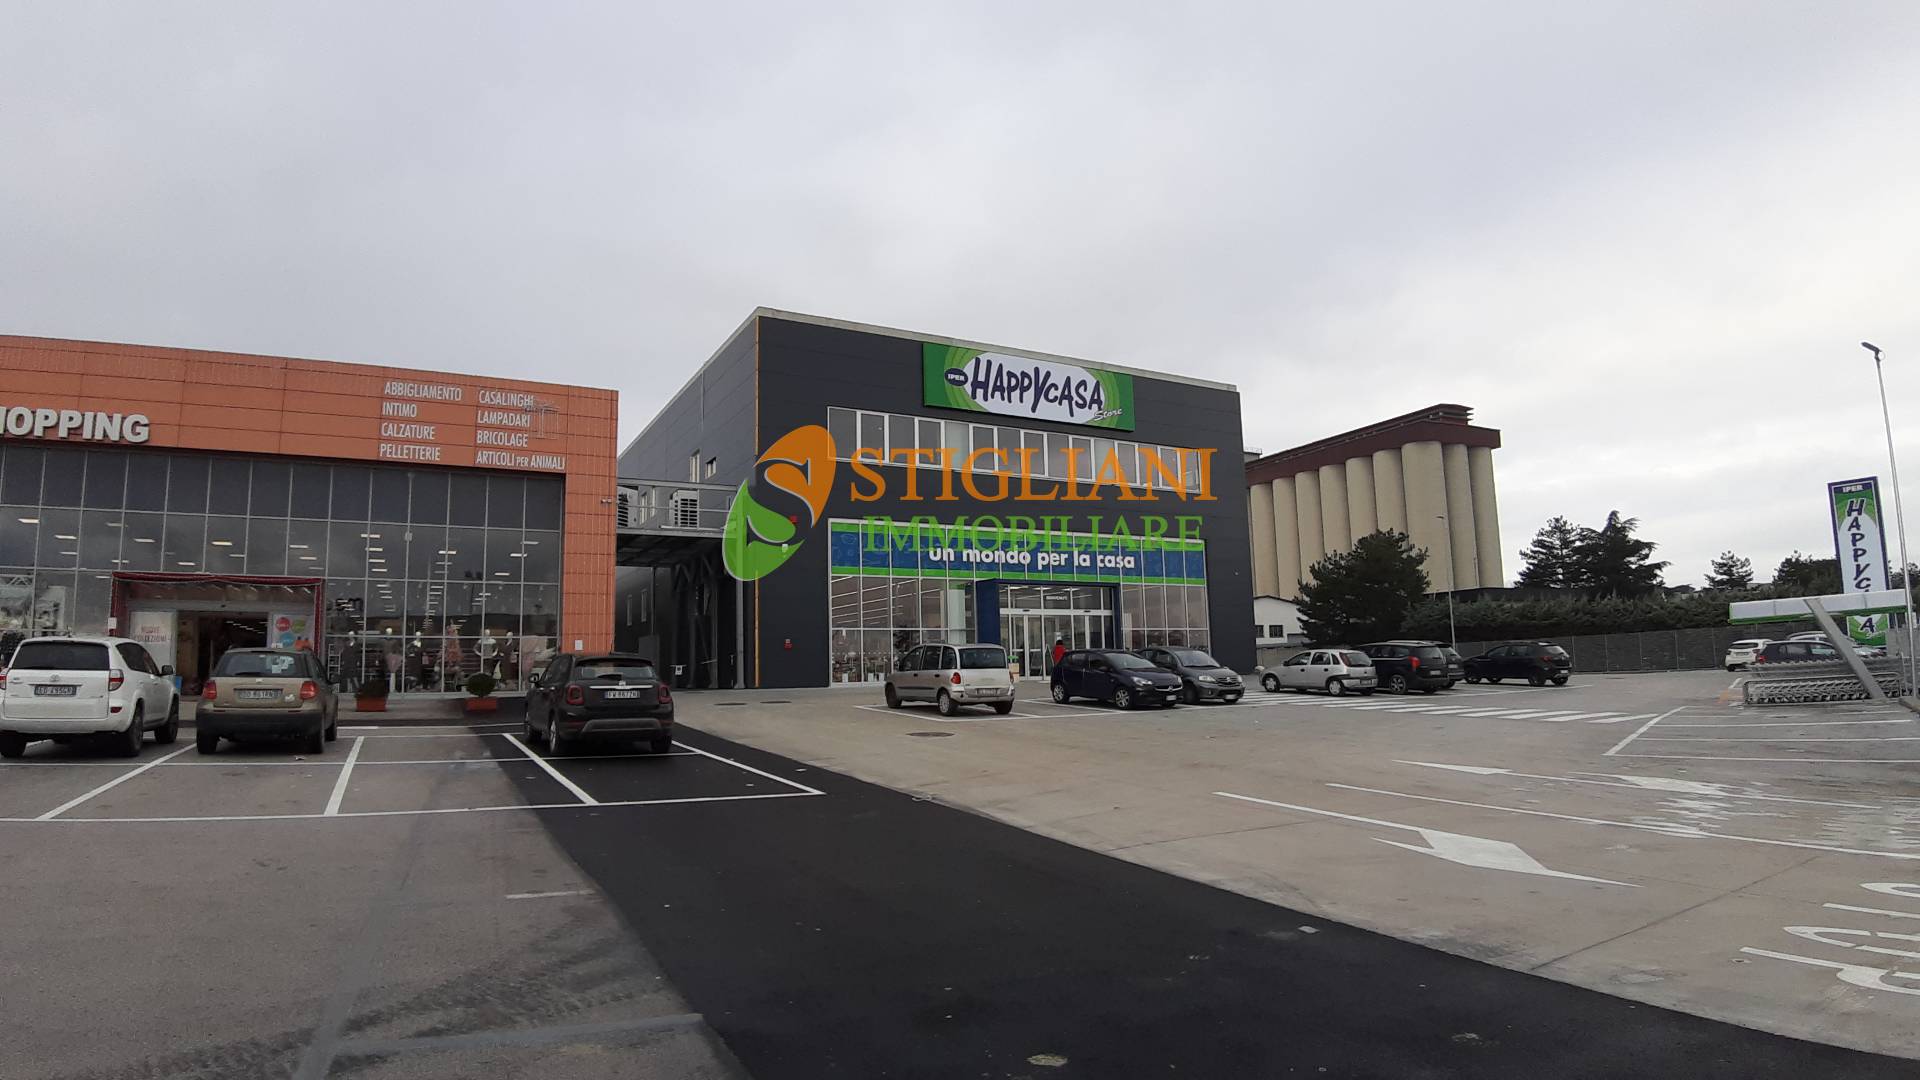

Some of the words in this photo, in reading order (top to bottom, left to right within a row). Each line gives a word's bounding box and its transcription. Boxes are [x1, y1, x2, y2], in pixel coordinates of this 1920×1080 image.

[947, 373, 966, 382] IPER
[384, 381, 462, 401] ABBIGLIAMENTO
[382, 402, 417, 418] INTIMO
[477, 410, 531, 428] LAMPADARI
[381, 422, 435, 440] CALZATURE
[476, 430, 528, 448] BRICOLAGE
[379, 443, 440, 461] PELLETTERIE
[476, 451, 515, 467] ARTICOLI
[530, 454, 566, 470] ANIMALI
[1842, 485, 1863, 493] IPER
[962, 545, 1032, 565] mondo
[1037, 553, 1068, 570] per
[1073, 551, 1090, 567] la
[1097, 555, 1135, 569] casa
